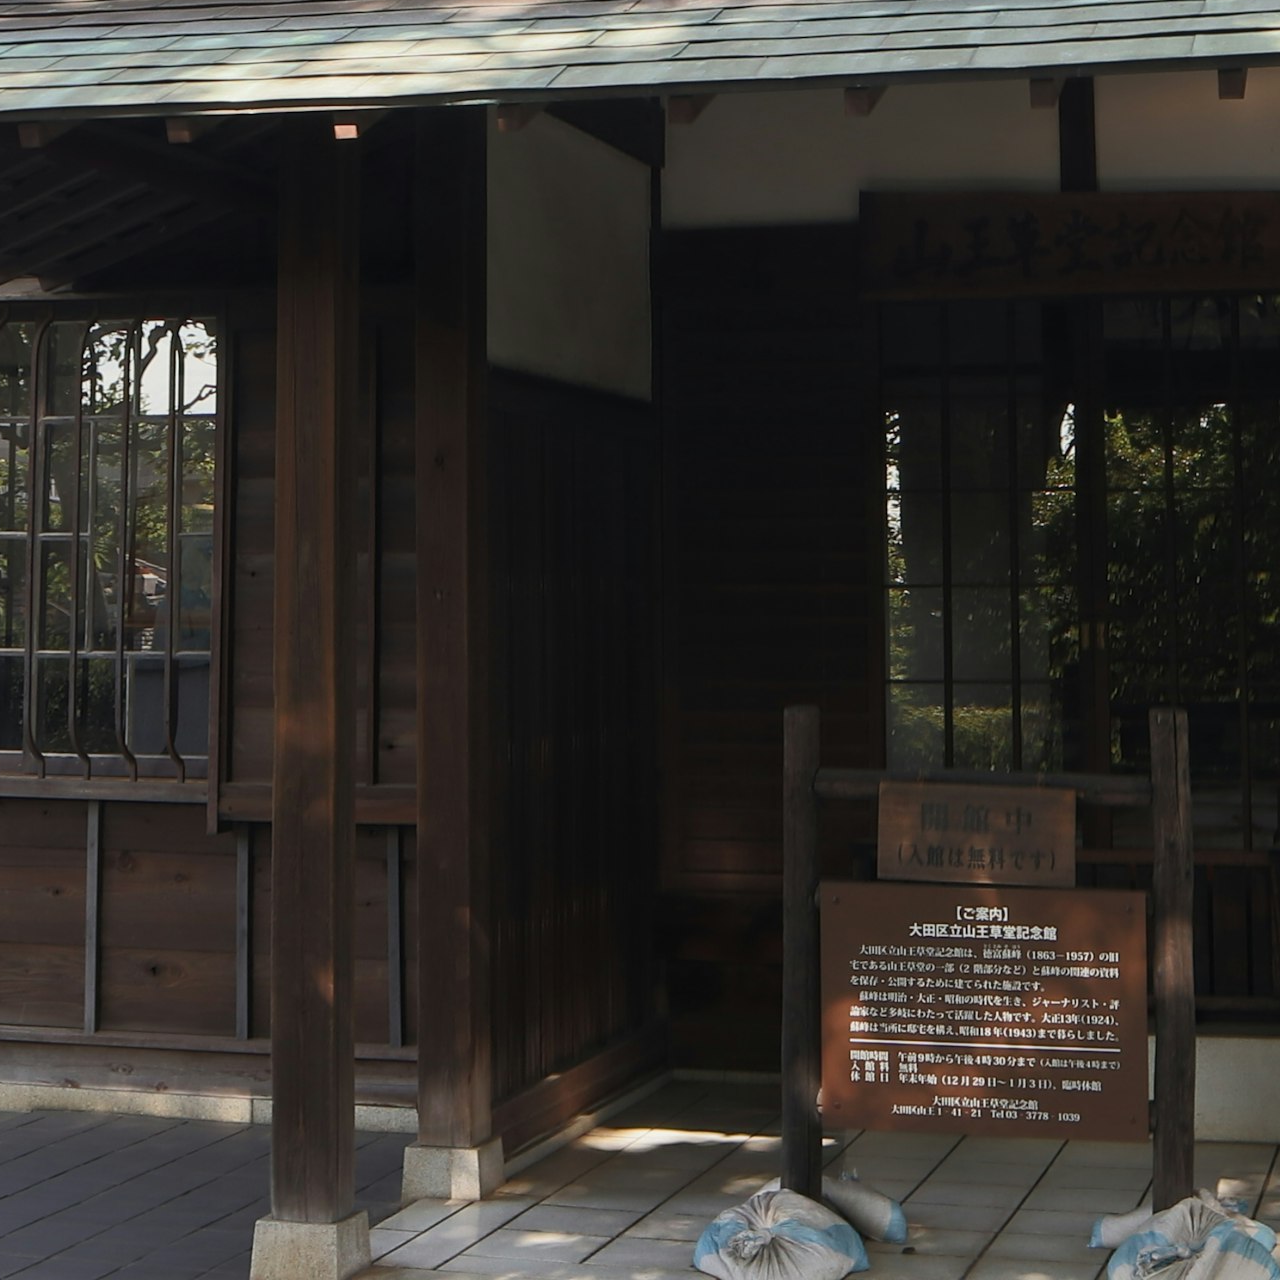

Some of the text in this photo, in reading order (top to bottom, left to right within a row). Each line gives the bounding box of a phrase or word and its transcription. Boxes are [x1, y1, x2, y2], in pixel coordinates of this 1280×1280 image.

[921, 802, 1032, 835] 開館中
[955, 906, 1009, 922] 【ご案内】
[908, 923, 1058, 942] 大田区立山王草堂記念館
[850, 975, 1045, 993] を保存・公開するために建てられた施設です。
[850, 1050, 889, 1061] 開館時間
[898, 1063, 918, 1074] 無料
[932, 1095, 1039, 1111] 大田区立山王草堂記念館
